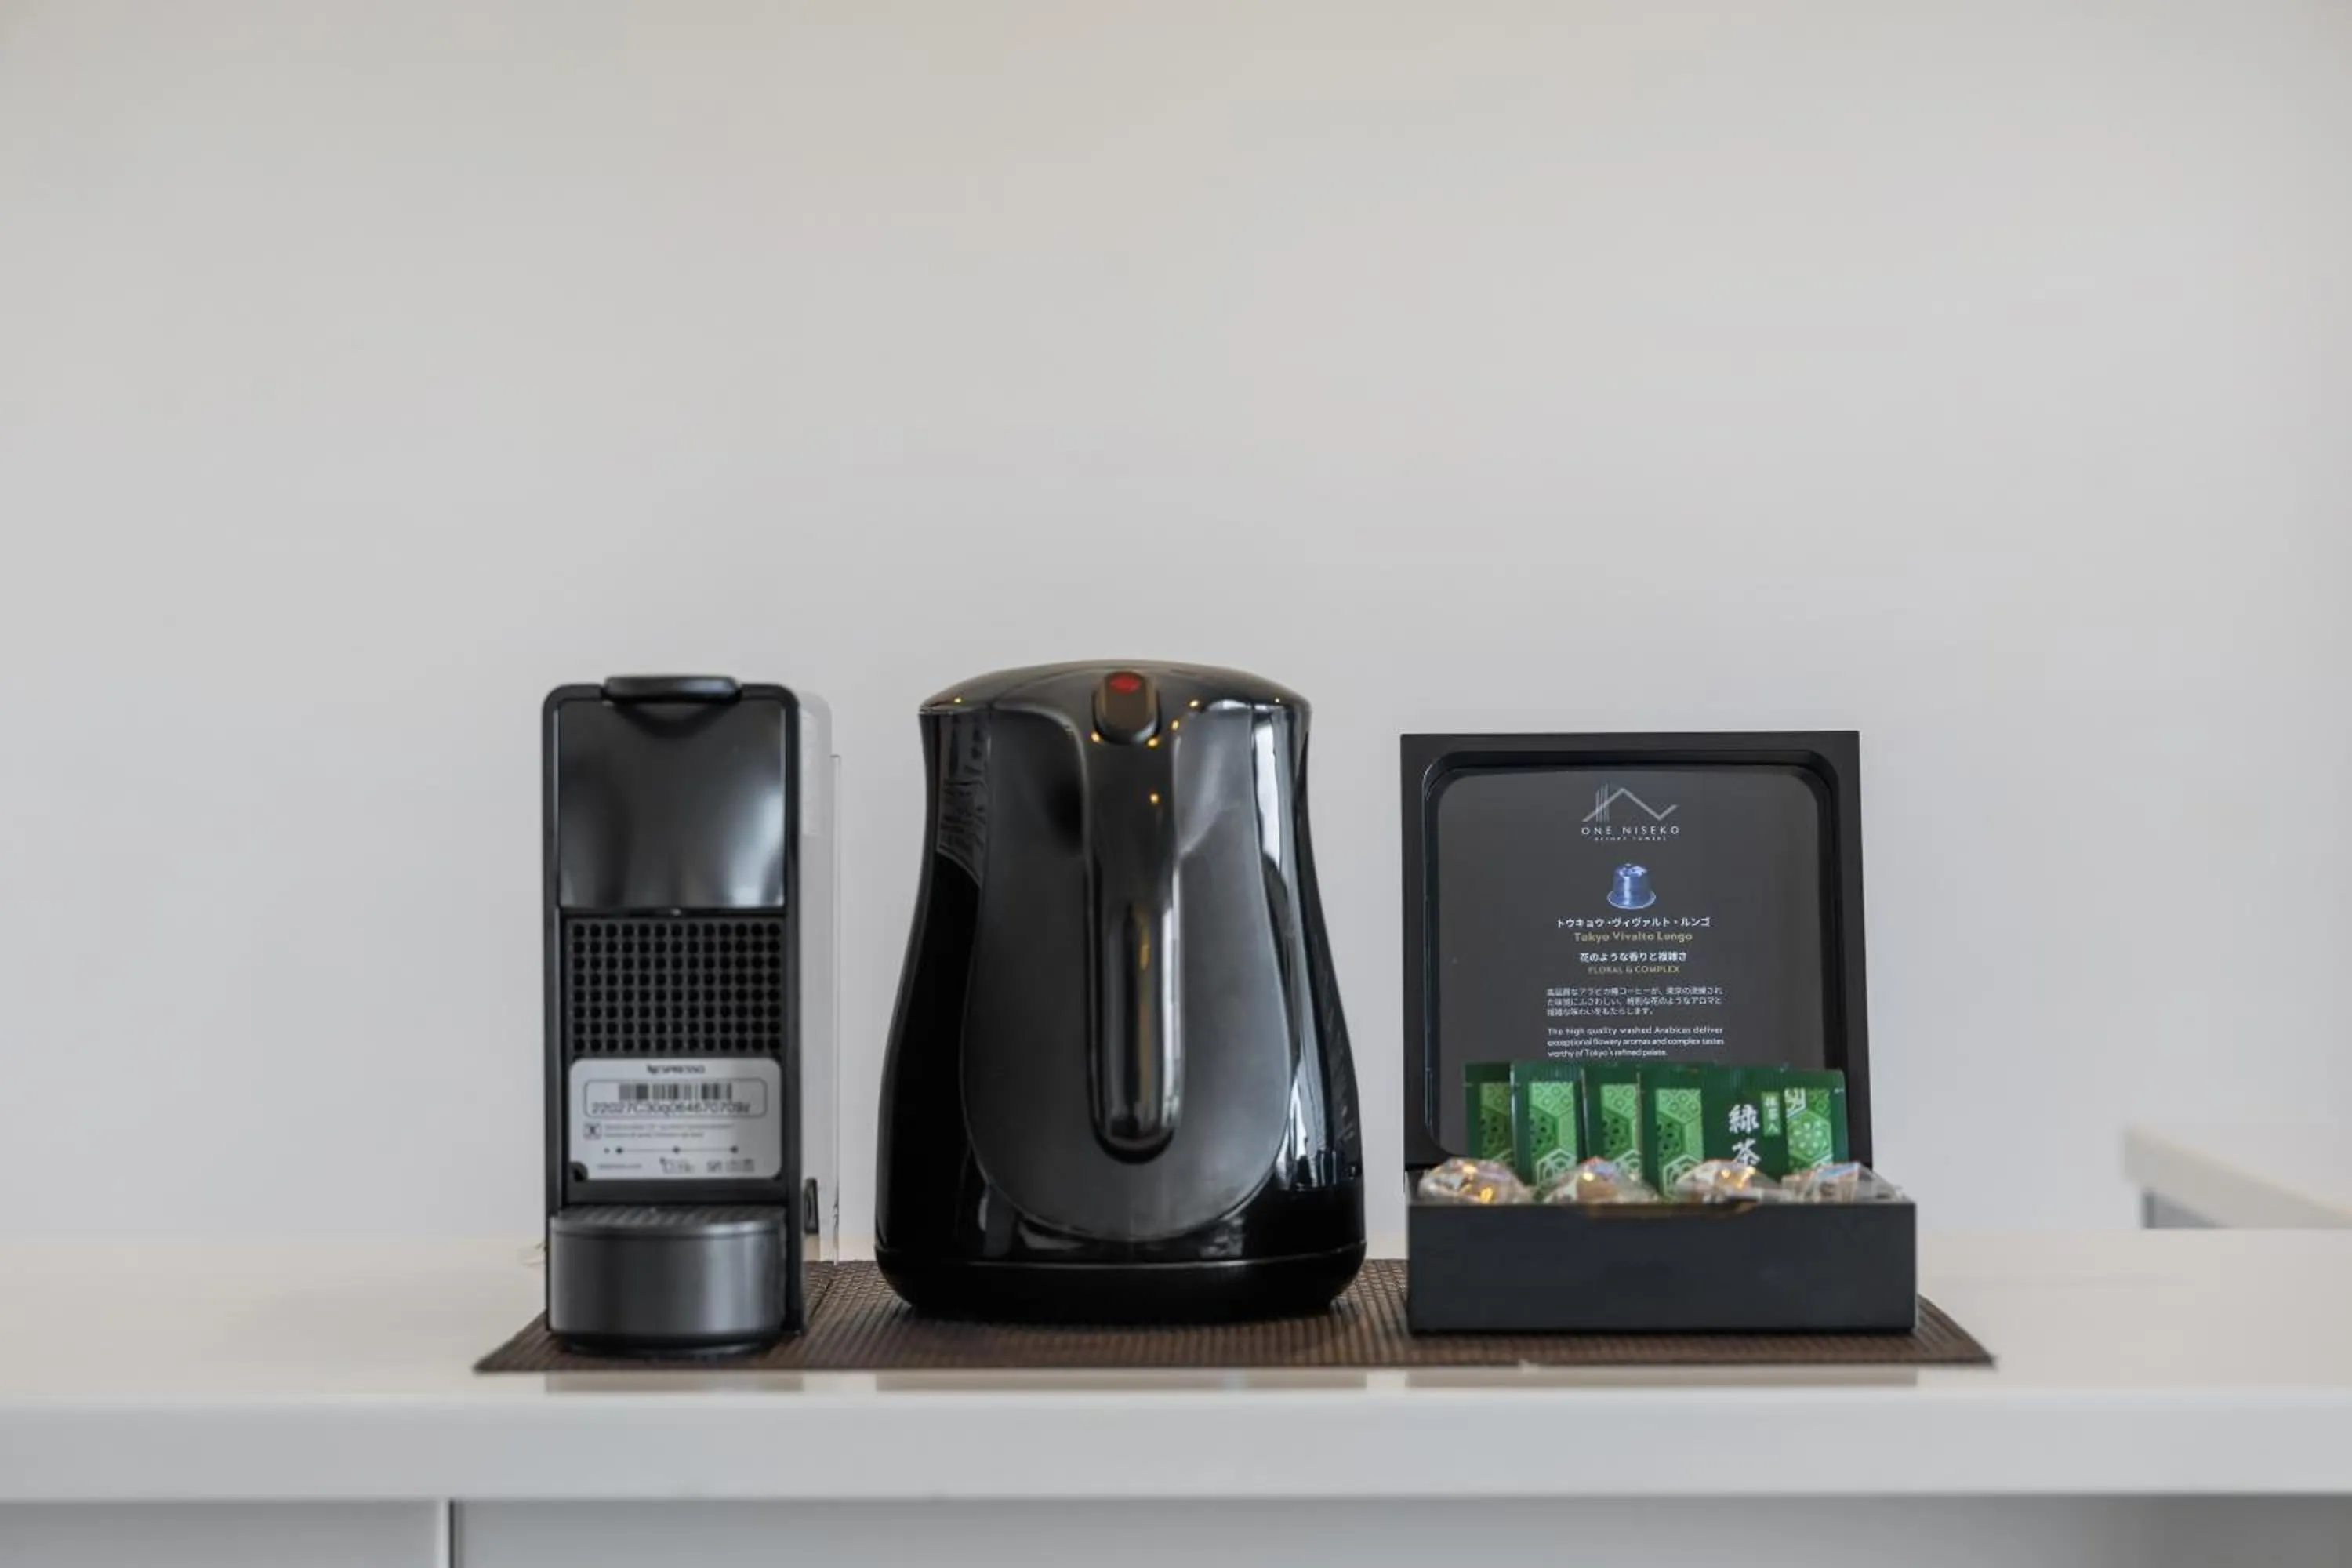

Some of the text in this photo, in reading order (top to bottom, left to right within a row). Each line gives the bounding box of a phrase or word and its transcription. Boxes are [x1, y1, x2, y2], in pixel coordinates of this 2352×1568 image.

[1581, 826, 1679, 835] ONE NISEKO
[1574, 931, 1693, 943] Tokyo Vivalto Lungo
[1588, 966, 1623, 975] FLORAL
[1635, 965, 1680, 974] COMPLEX
[1586, 1027, 1617, 1036] quality
[1693, 1025, 1722, 1034] deliver
[1593, 1037, 1621, 1047] flowery
